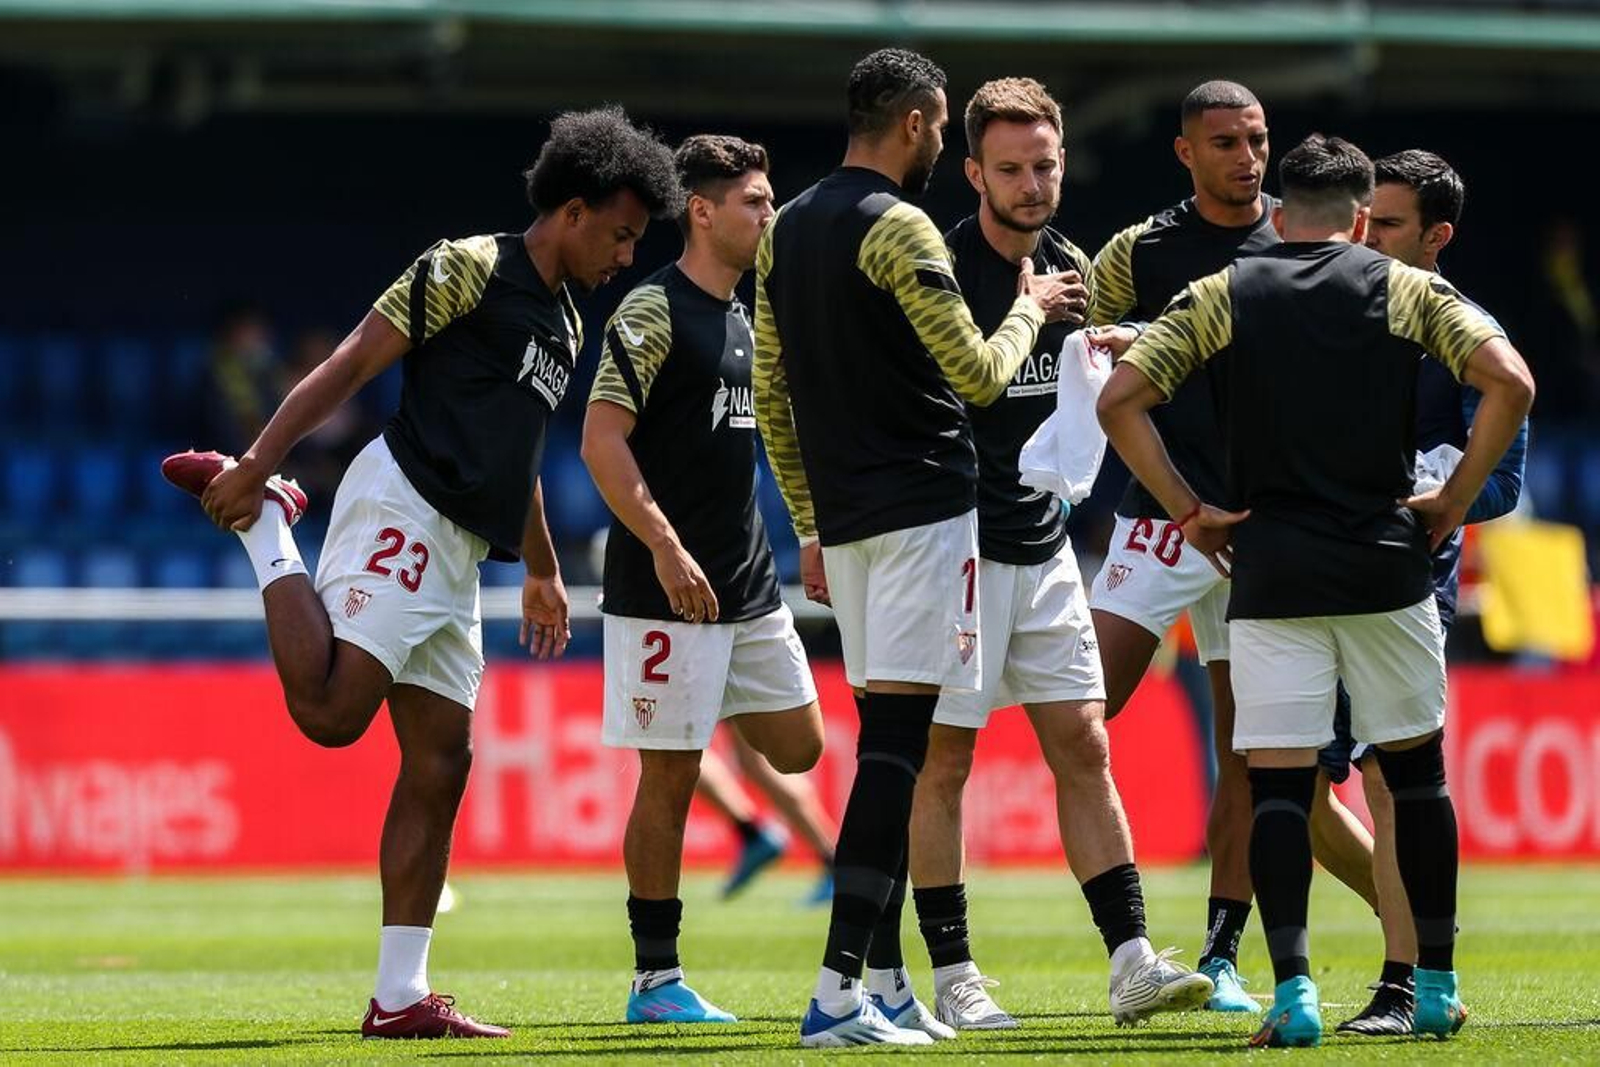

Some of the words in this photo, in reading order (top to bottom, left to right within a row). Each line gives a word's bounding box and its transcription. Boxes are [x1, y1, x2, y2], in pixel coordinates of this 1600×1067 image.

[534, 347, 569, 402] NAGA
[362, 527, 430, 593] 23
[1123, 517, 1184, 568] 20
[640, 630, 672, 685] 2
